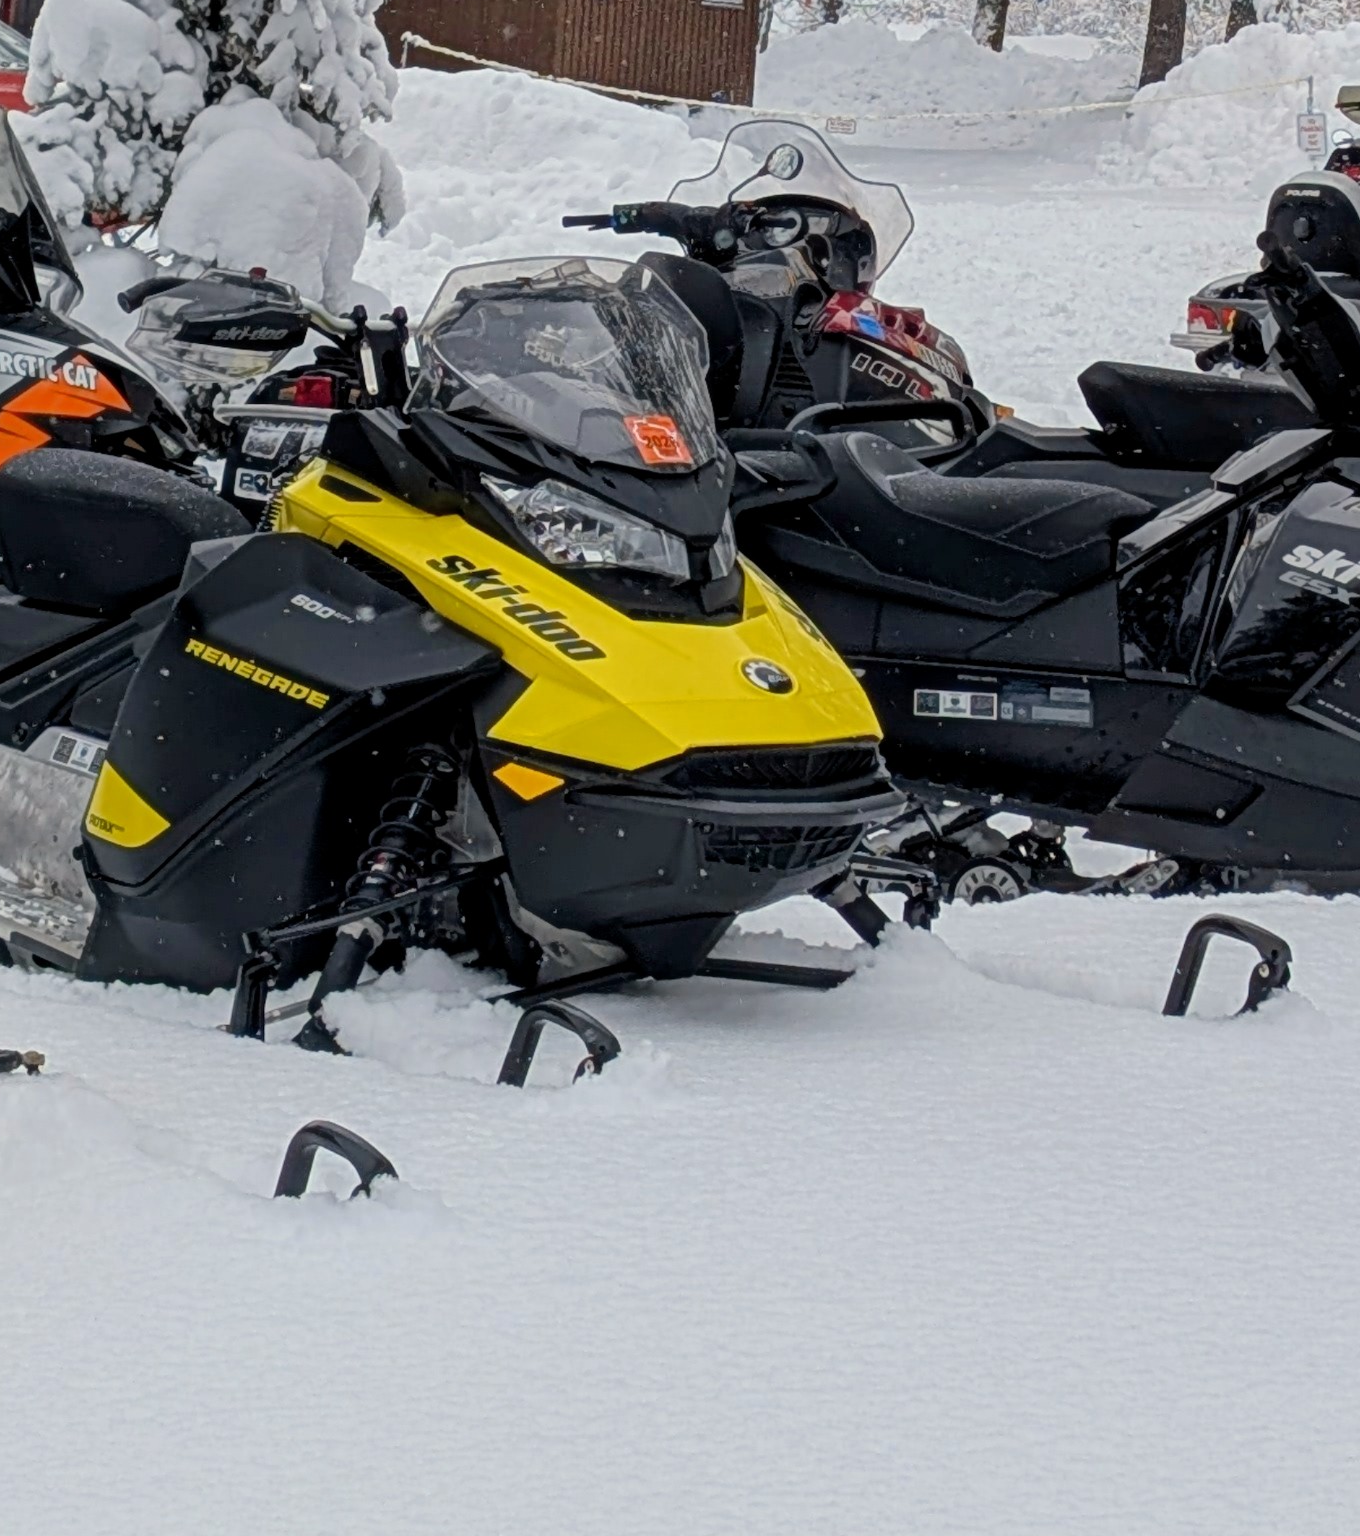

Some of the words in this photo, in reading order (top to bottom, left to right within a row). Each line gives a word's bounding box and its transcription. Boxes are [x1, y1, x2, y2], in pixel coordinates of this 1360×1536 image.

[212, 325, 289, 341] ski-doo
[62, 361, 99, 391] CAT
[290, 593, 336, 619] 600
[425, 555, 607, 661] ski-doo
[185, 638, 330, 710] RENEGADE
